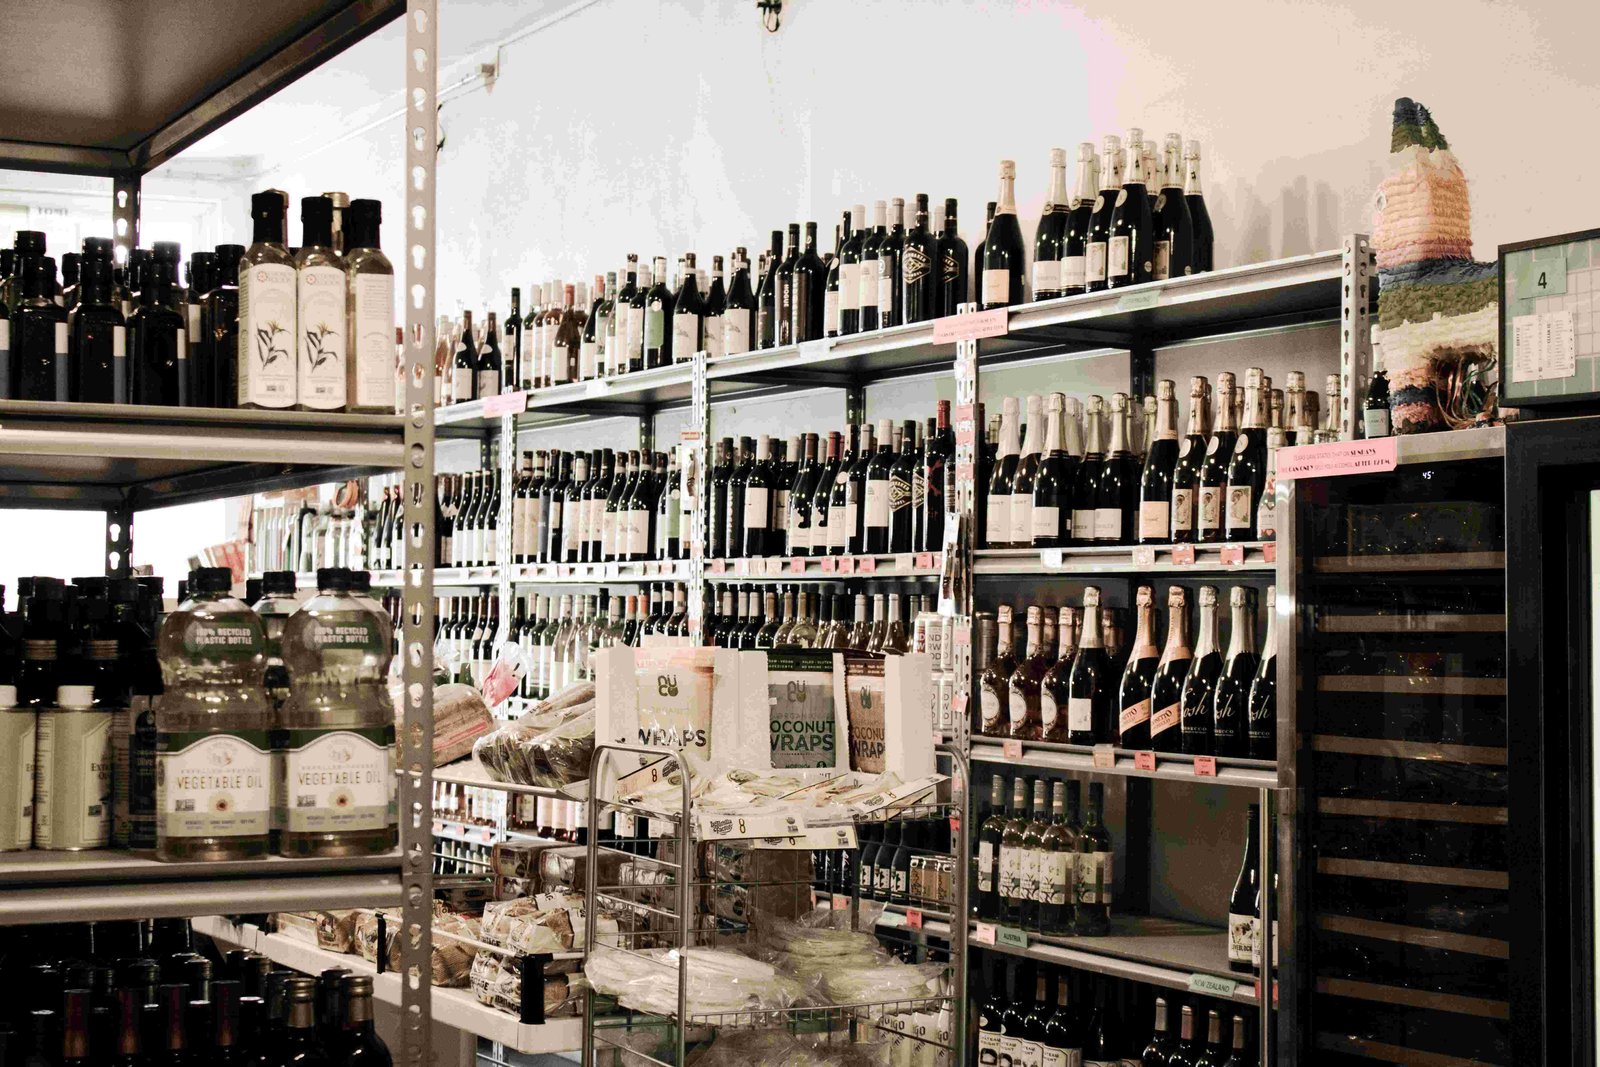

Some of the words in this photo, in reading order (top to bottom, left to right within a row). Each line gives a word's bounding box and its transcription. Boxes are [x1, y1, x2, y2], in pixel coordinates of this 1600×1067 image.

[1538, 272, 1547, 289] 4
[228, 636, 252, 645] BOTTLE
[345, 635, 369, 643] BOTTLE
[850, 740, 885, 758] WRAP
[177, 775, 241, 790] VEGETABLE
[247, 775, 263, 789] OIL
[298, 771, 361, 786] VEGETABLE
[366, 770, 381, 784] OIL
[651, 768, 658, 783] 8
[738, 818, 746, 834] 8
[1003, 932, 1022, 943] AUSTRIA
[1194, 979, 1205, 988] NEW
[1206, 980, 1230, 993] ZEALAND
